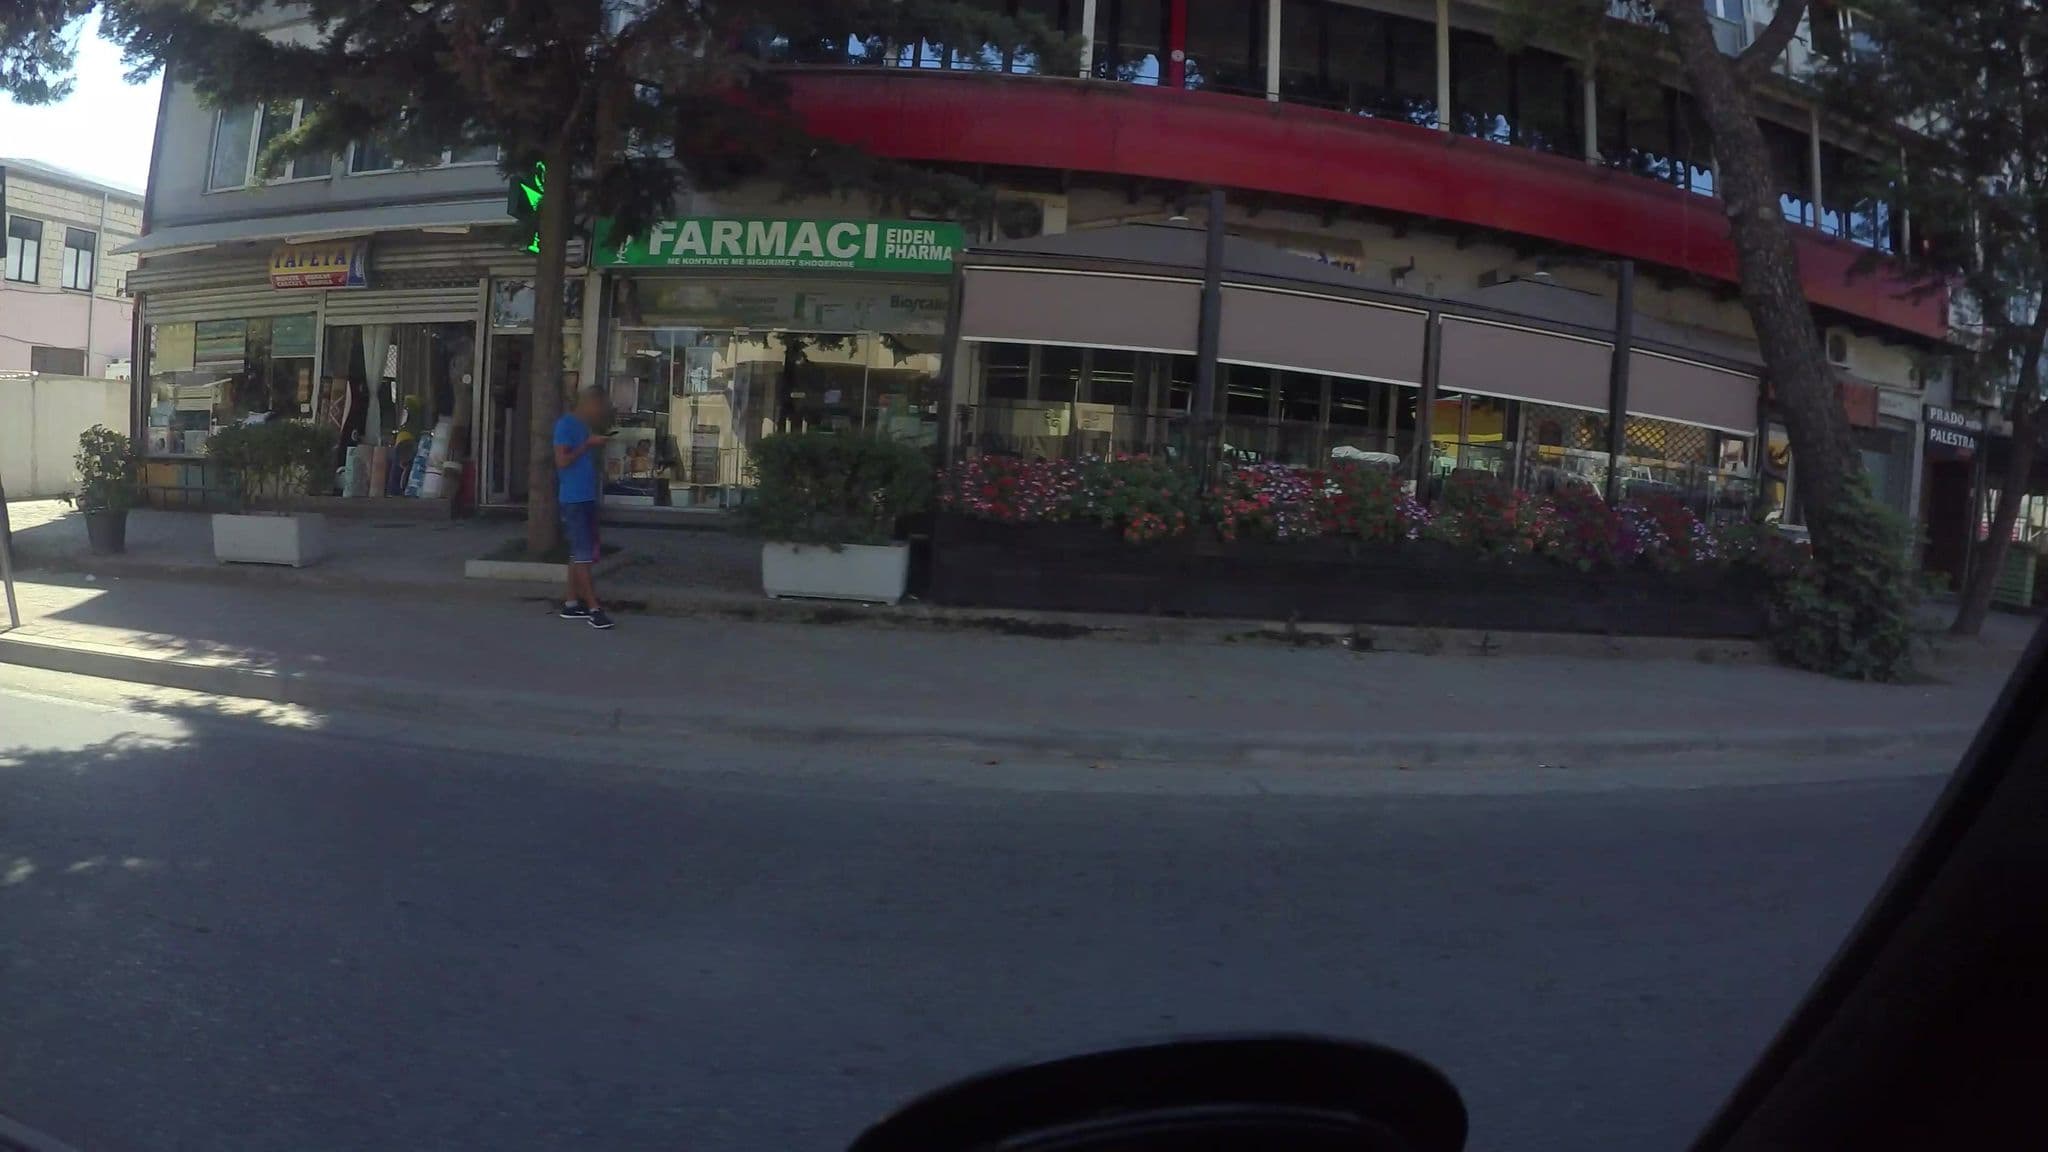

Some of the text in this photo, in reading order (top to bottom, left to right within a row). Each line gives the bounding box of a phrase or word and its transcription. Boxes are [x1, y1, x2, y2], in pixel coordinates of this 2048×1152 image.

[649, 220, 879, 259] FARMACI
[885, 228, 936, 245] EIDEN
[884, 243, 953, 261] PHARMA
[667, 257, 681, 265] ME
[682, 257, 729, 266] KONTRATE
[731, 258, 745, 266] ME
[747, 258, 798, 267] SIGURIMET
[1930, 407, 1964, 426] PRADO
[1930, 428, 1975, 449] PALESTRA
